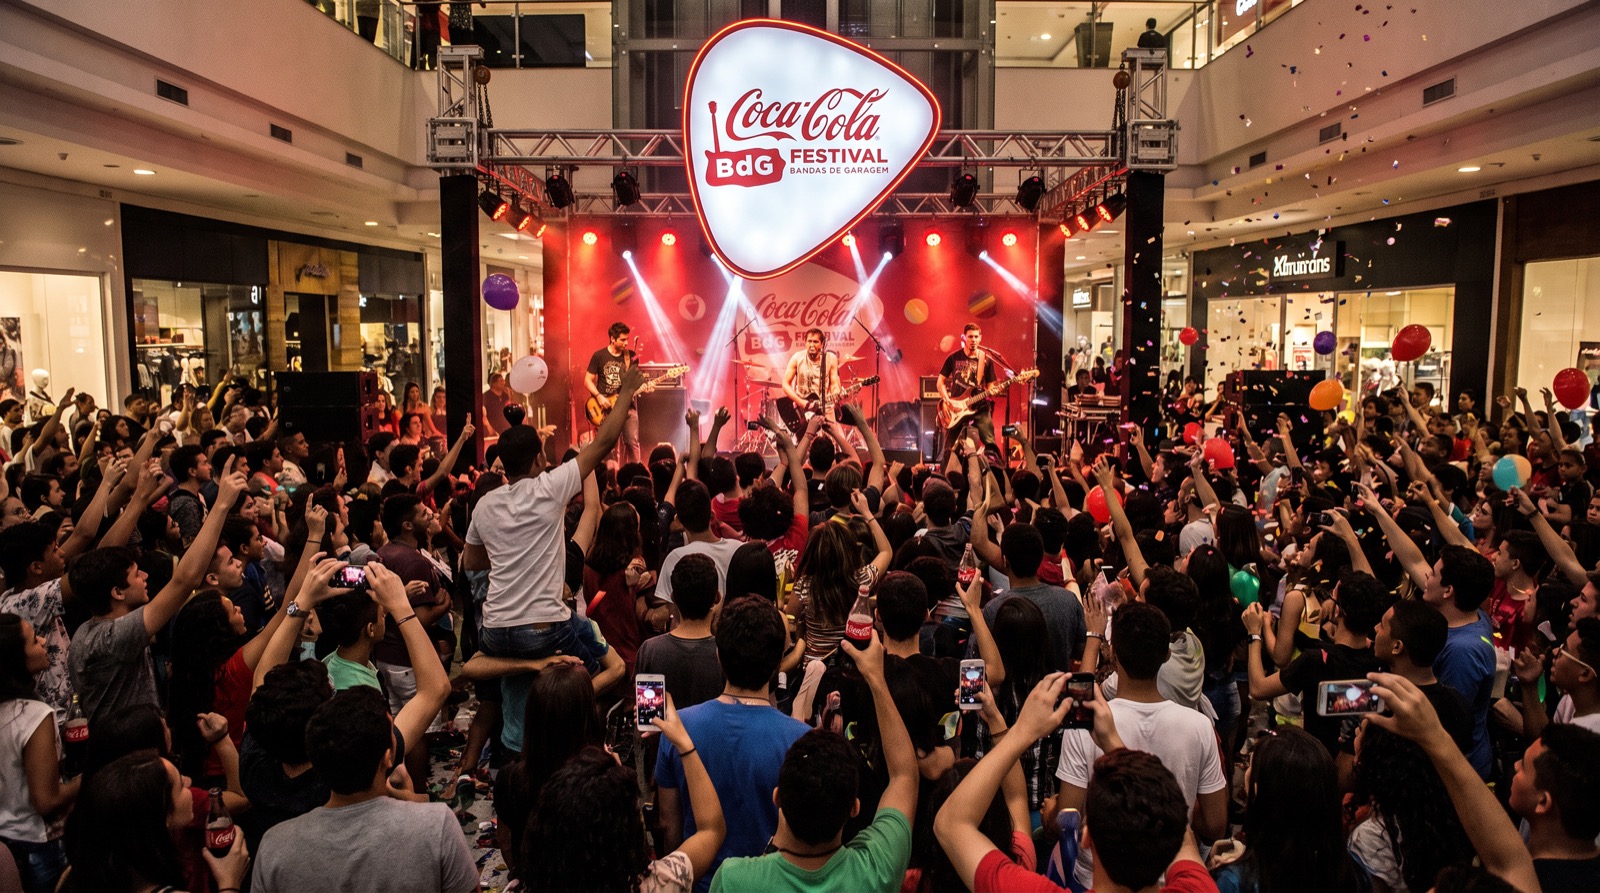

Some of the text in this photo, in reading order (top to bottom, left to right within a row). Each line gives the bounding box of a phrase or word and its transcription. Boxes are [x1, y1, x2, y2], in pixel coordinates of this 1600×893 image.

[725, 88, 890, 142] Coca-Cola
[716, 154, 774, 178] BdG
[790, 148, 889, 164] FESTIVAL
[790, 166, 889, 174] BANDAS DE GARAGEM
[755, 293, 857, 328] Coca-Cola
[795, 331, 855, 342] FEIVAL
